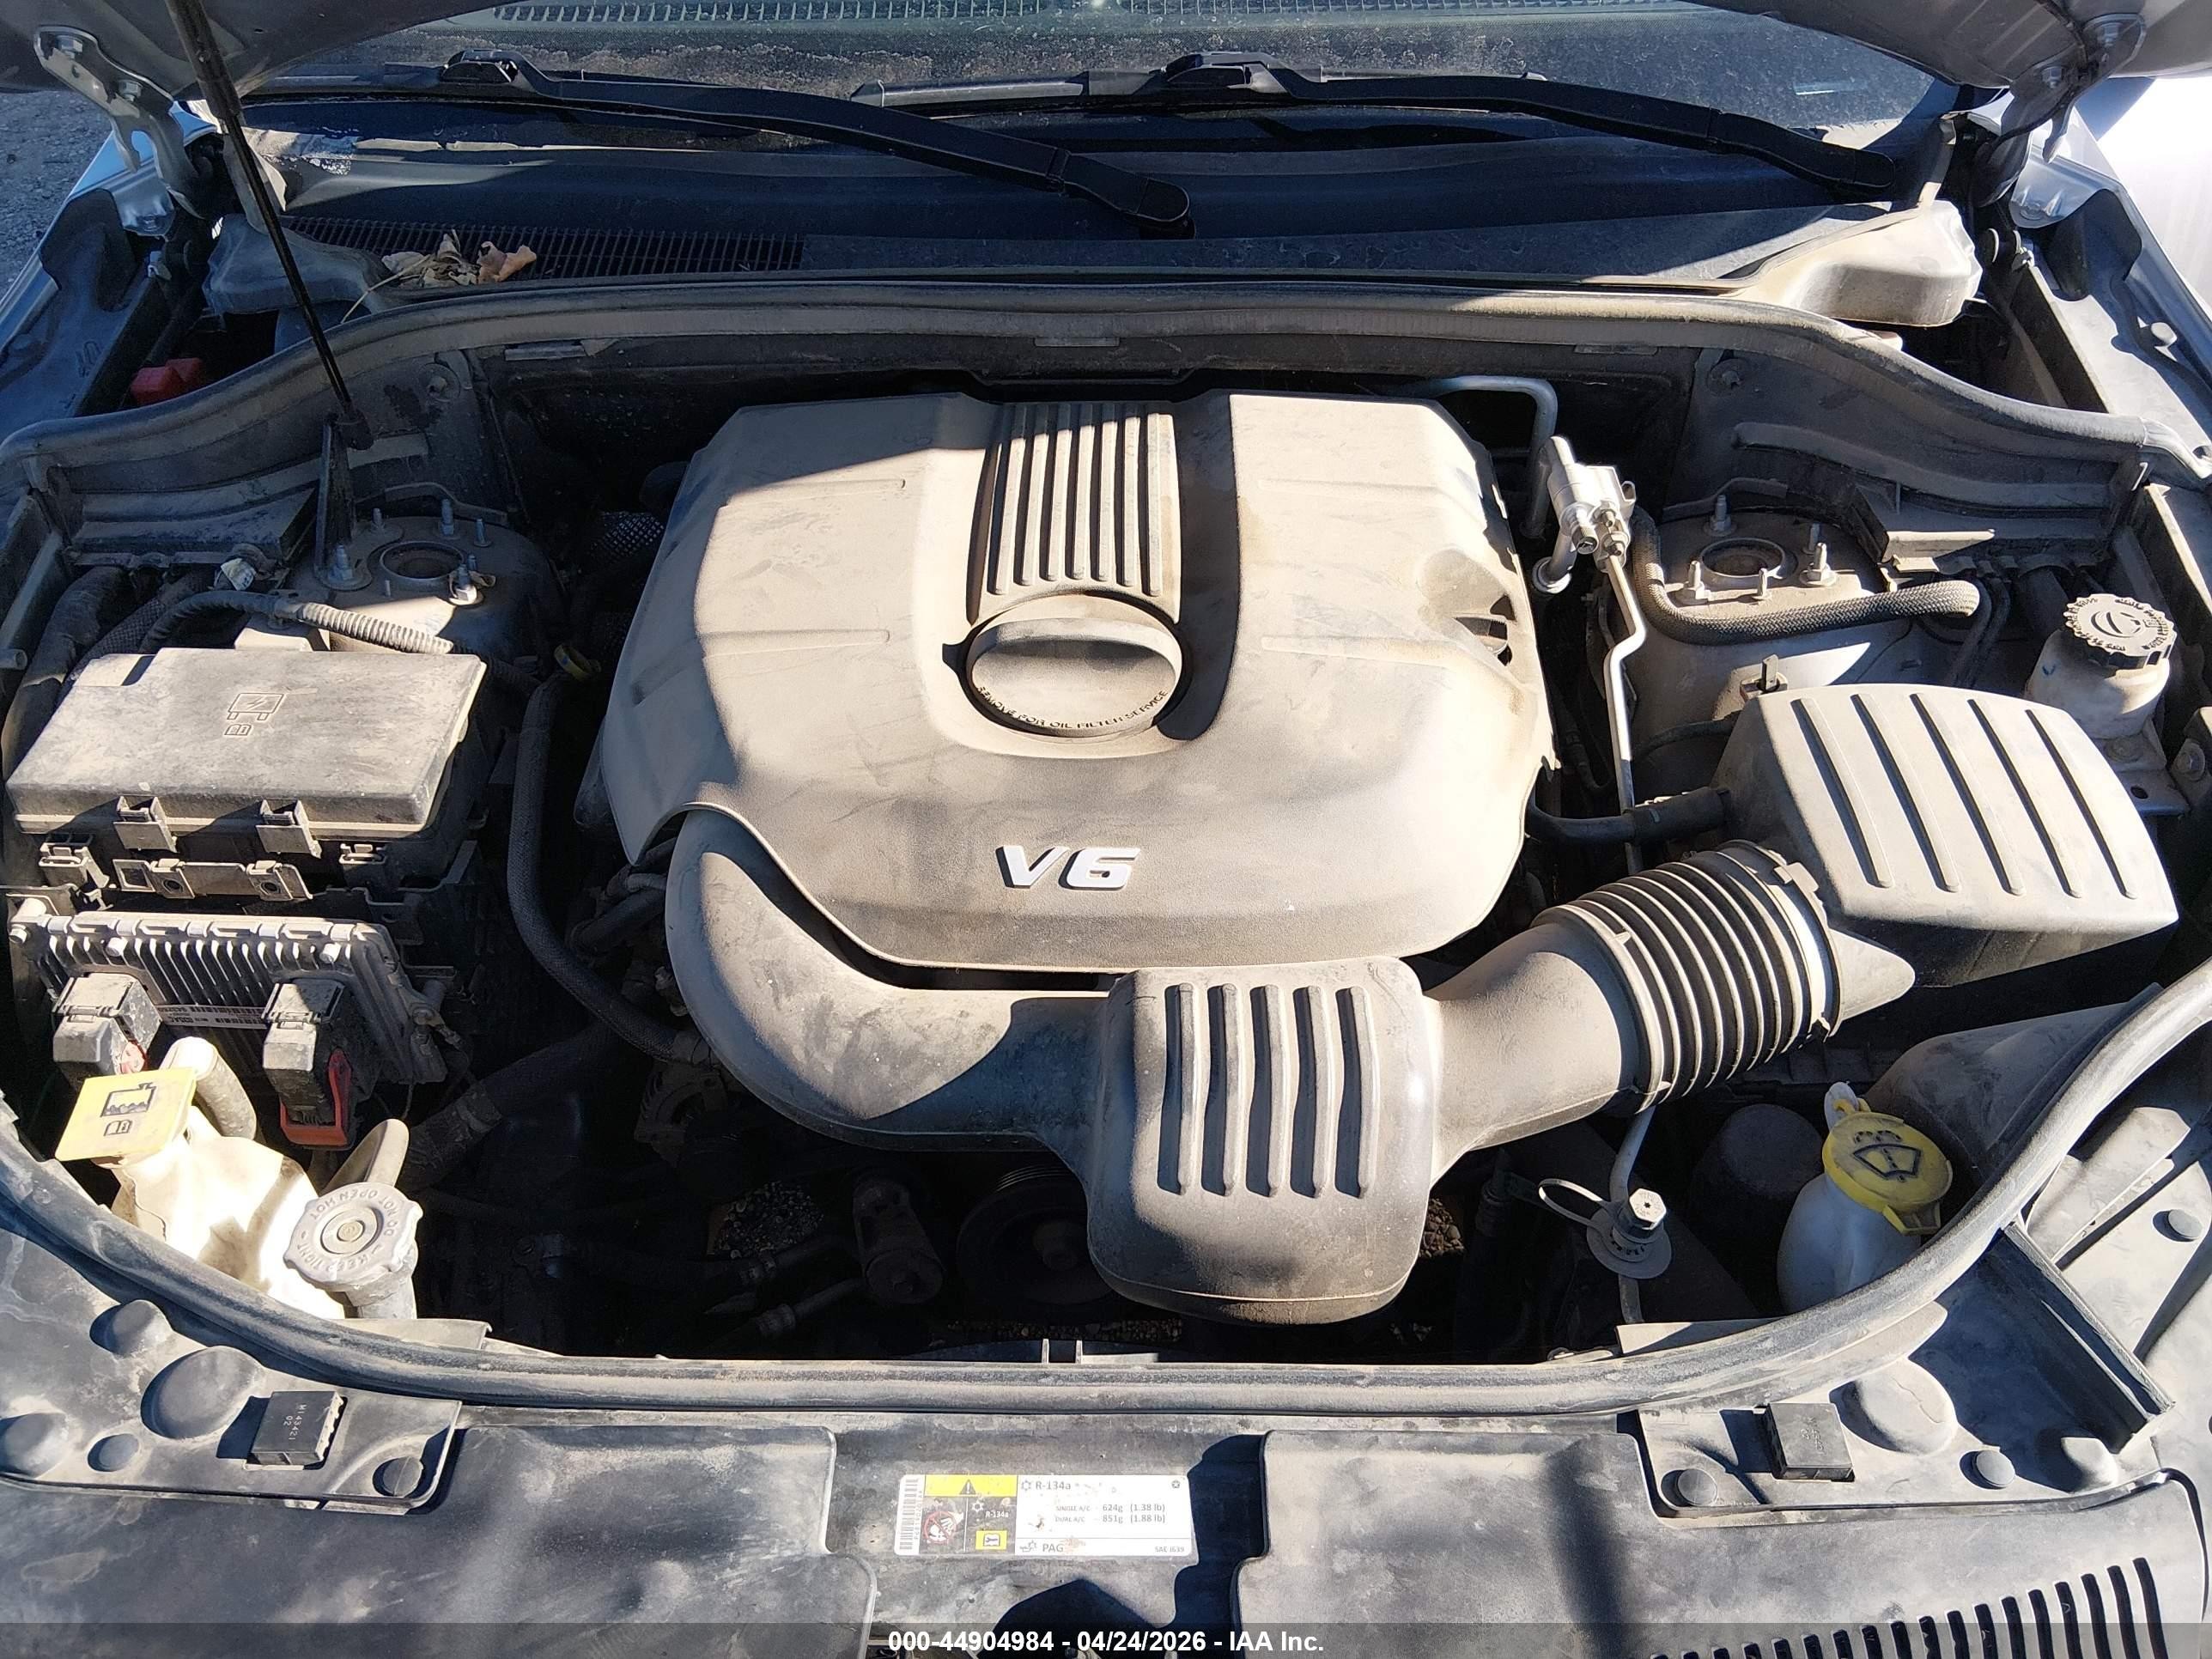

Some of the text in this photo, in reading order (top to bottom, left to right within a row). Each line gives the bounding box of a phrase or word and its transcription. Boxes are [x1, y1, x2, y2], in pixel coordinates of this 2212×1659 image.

[1018, 714, 1045, 727] FOR
[1076, 716, 1123, 729] FILTER
[1125, 690, 1169, 719] SERVICE
[995, 845, 1141, 891] V6
[309, 1188, 399, 1237] DO NOT OPEN HOT
[296, 1243, 369, 1273] KEEP TIGHT
[1036, 1480, 1072, 1491] R-134a
[1103, 1504, 1123, 1513] 624g
[1130, 1504, 1152, 1513] (1.38
[1153, 1504, 1165, 1513] lb)
[1103, 1514, 1123, 1524] 851g
[1130, 1514, 1152, 1524] (1.88
[1153, 1514, 1165, 1524] lb)
[1042, 1543, 1064, 1553] PAG
